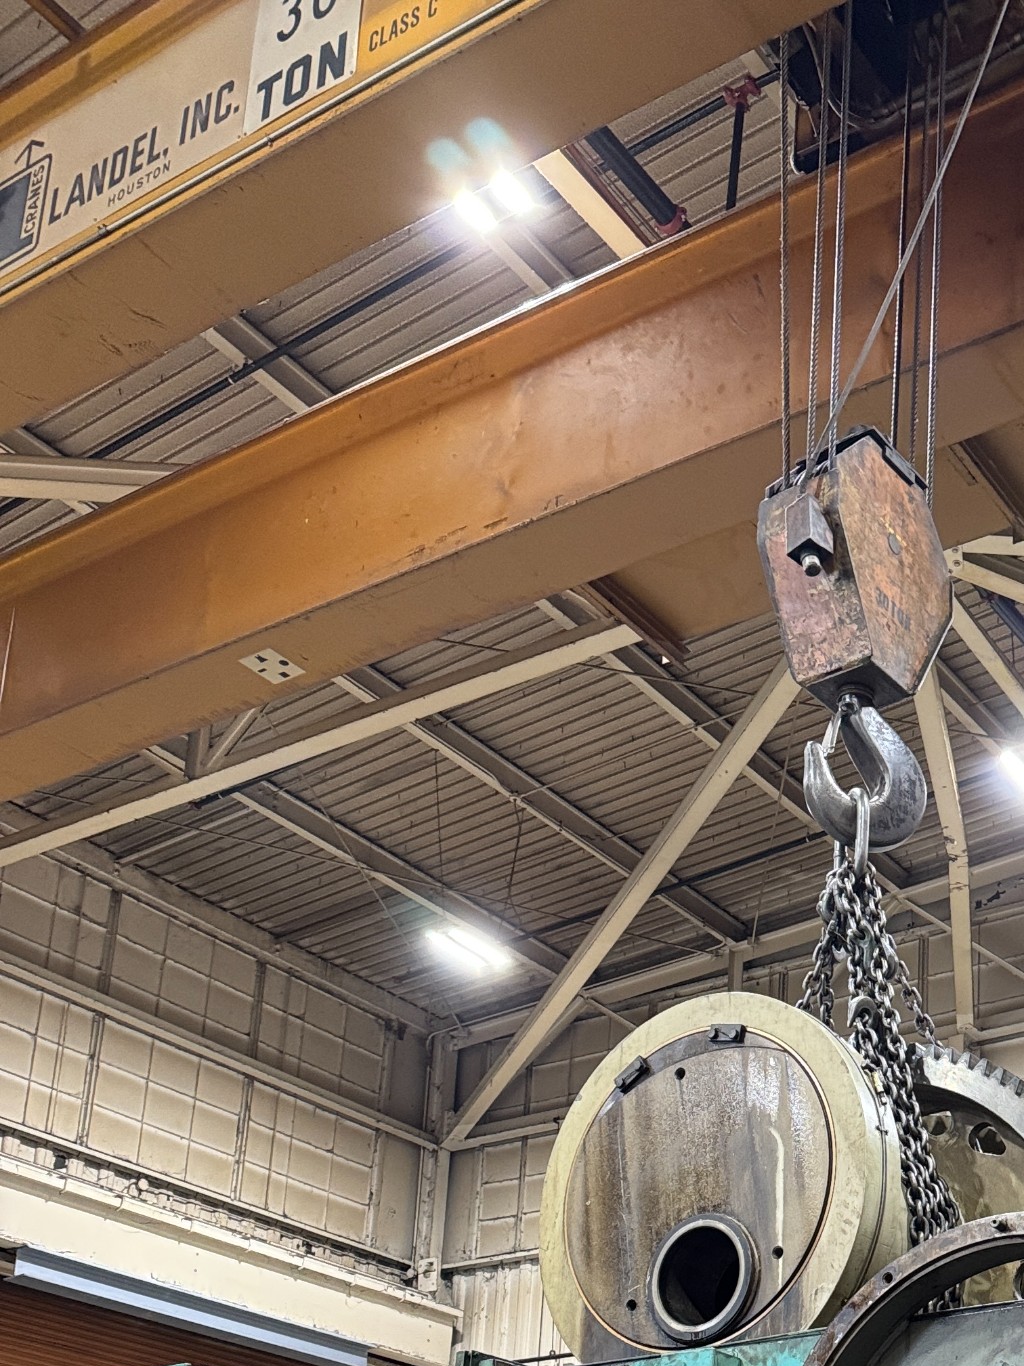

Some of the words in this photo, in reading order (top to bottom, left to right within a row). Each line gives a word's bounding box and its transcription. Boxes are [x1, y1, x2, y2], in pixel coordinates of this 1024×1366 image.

[369, 6, 420, 52] CLASS
[428, 0, 438, 18] C
[257, 31, 348, 122] TON
[48, 126, 169, 225] LANDEL,
[179, 80, 239, 146] INC.
[107, 160, 171, 207] HOUSTON
[24, 165, 45, 234] CRANES
